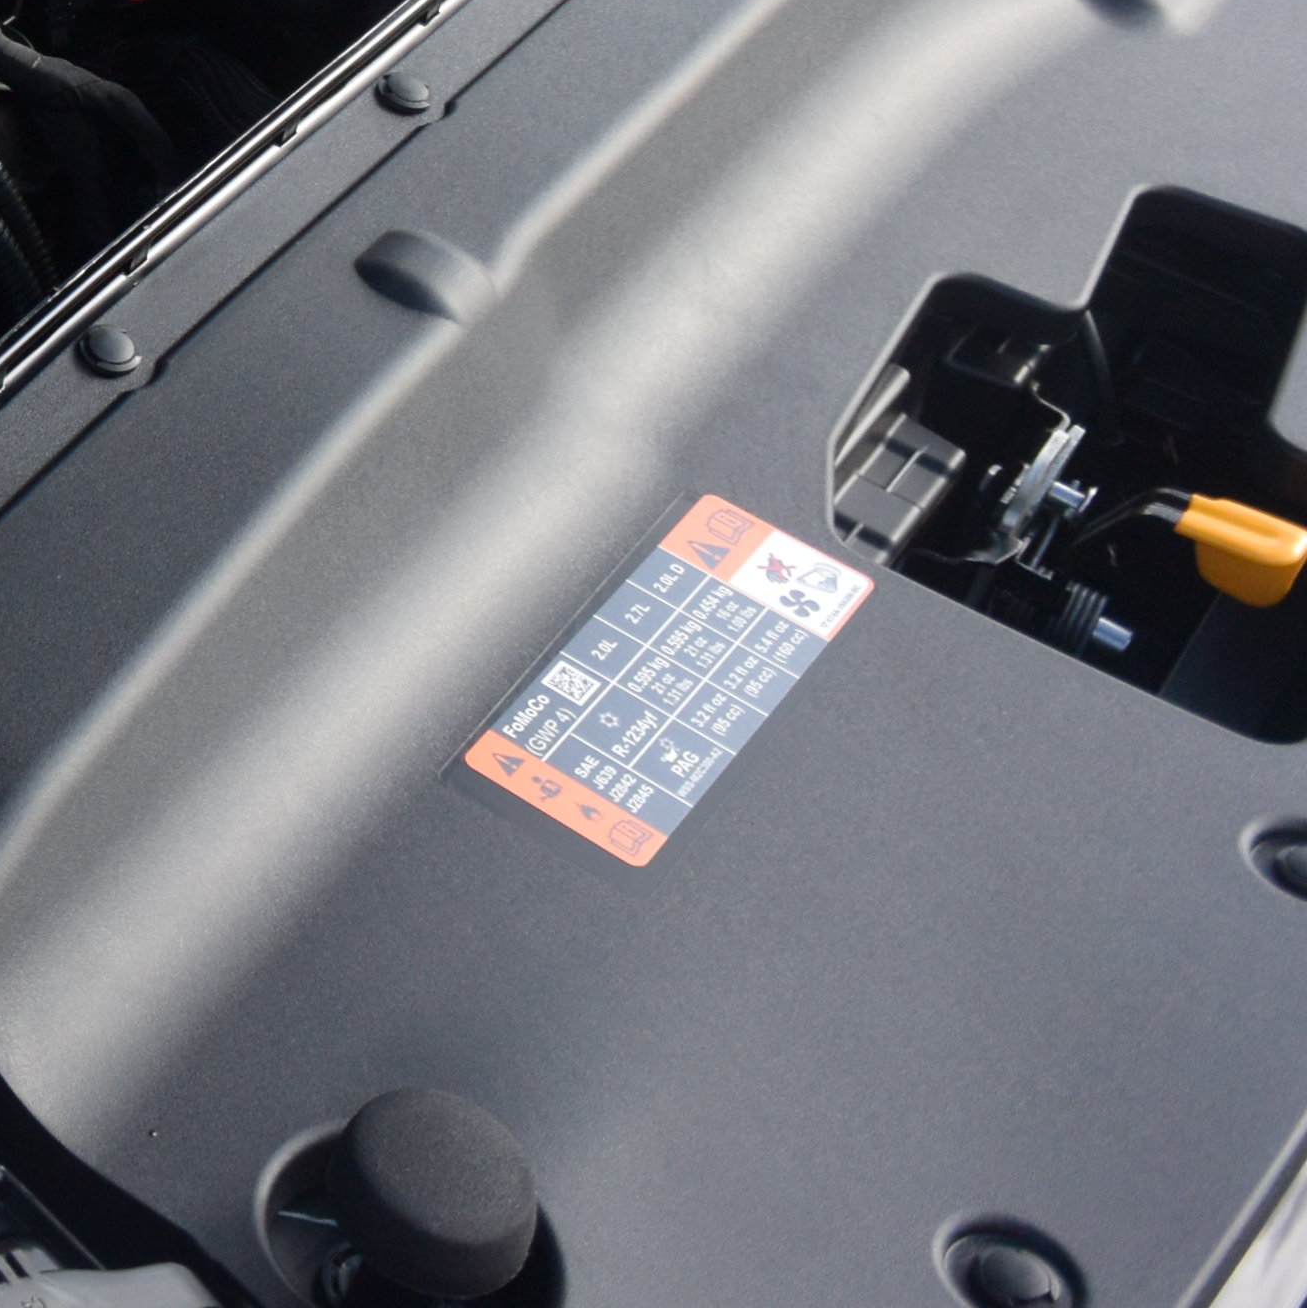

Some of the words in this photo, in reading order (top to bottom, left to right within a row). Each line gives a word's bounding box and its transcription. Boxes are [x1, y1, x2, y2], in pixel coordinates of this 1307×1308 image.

[653, 574, 678, 593] 2.0L
[669, 563, 685, 575] D
[624, 604, 651, 625] 2.7L
[692, 597, 720, 620] 0.454
[710, 585, 734, 598] kg
[725, 601, 740, 612] oz
[739, 606, 758, 619] lbs
[591, 639, 618, 661] 2.0L
[660, 630, 689, 655] 0.595
[679, 620, 703, 635] kg
[683, 645, 699, 658] 21
[694, 637, 708, 648] oz
[754, 637, 774, 654] 5.4
[765, 629, 780, 640] fl
[775, 621, 789, 634] oz
[772, 642, 796, 665] (160
[790, 629, 810, 645] cc)
[695, 652, 715, 669] 1.31
[707, 642, 726, 655] lbs
[627, 666, 656, 694] 0.595
[646, 656, 670, 671] kg
[651, 681, 666, 694] 21
[660, 673, 676, 684] oz
[723, 672, 744, 690] 3.2
[734, 664, 750, 676] fl
[744, 656, 759, 669] oz
[743, 679, 764, 698] (95
[758, 666, 778, 684] cc)
[663, 688, 683, 706] 1.31
[677, 678, 694, 692] lbs
[502, 695, 550, 739] FoMoCo
[690, 709, 711, 728] 3.2
[702, 702, 717, 714] fl
[711, 693, 728, 707] oz
[711, 717, 731, 737] (95
[726, 703, 746, 721] cc)
[525, 719, 559, 757] (GWP
[555, 708, 577, 722] 4)
[611, 710, 658, 758] R-1234yf
[574, 755, 600, 778] SAE
[593, 765, 617, 790] J639
[671, 751, 699, 778] PAG
[608, 773, 637, 803] J2842
[626, 784, 654, 813] J2845
